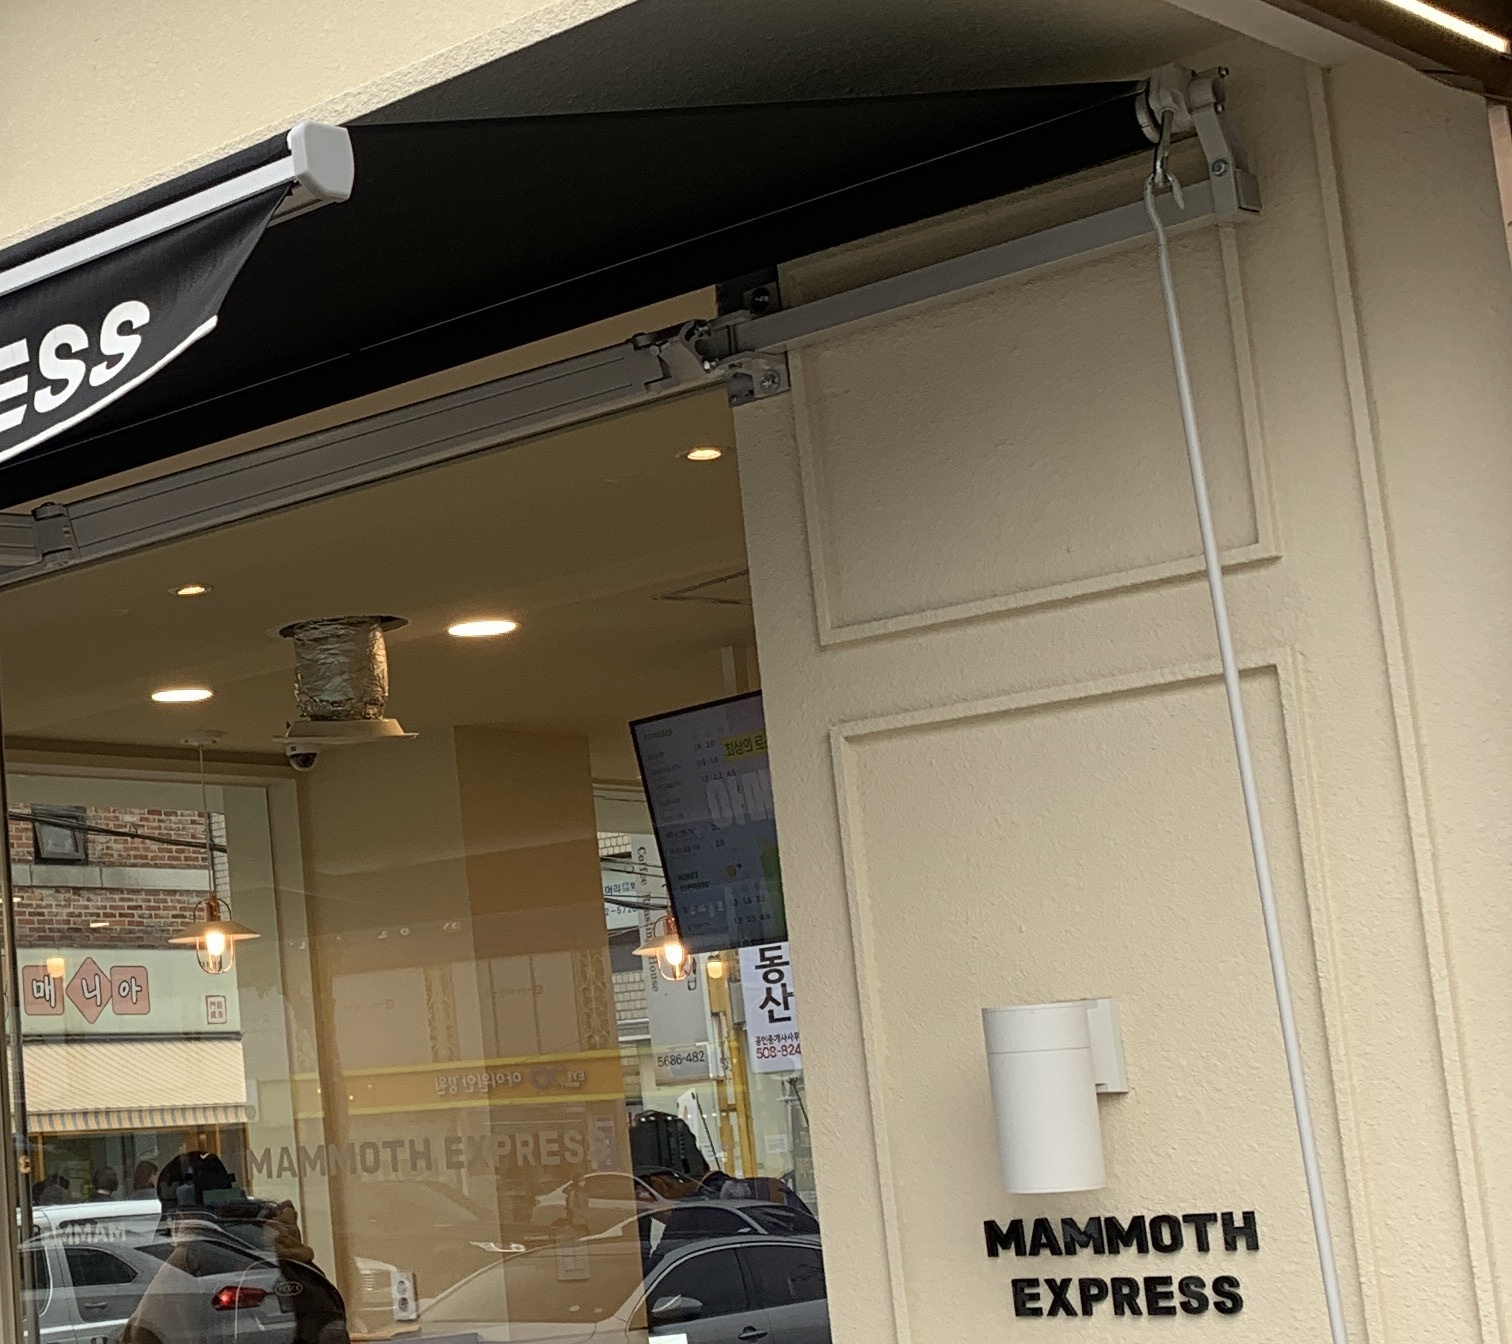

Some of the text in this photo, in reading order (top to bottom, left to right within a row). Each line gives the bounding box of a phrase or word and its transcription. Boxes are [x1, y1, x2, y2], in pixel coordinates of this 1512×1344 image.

[32, 972, 143, 1008] 매니아
[754, 945, 795, 1024] 동산
[754, 1031, 800, 1046] 공인중개사사무
[755, 1042, 801, 1059] 508-824
[247, 1126, 610, 1181] MAMMOTH EXPRESS
[983, 1211, 1260, 1259] MAMMOTH
[1011, 1275, 1245, 1319] EXPRESS
